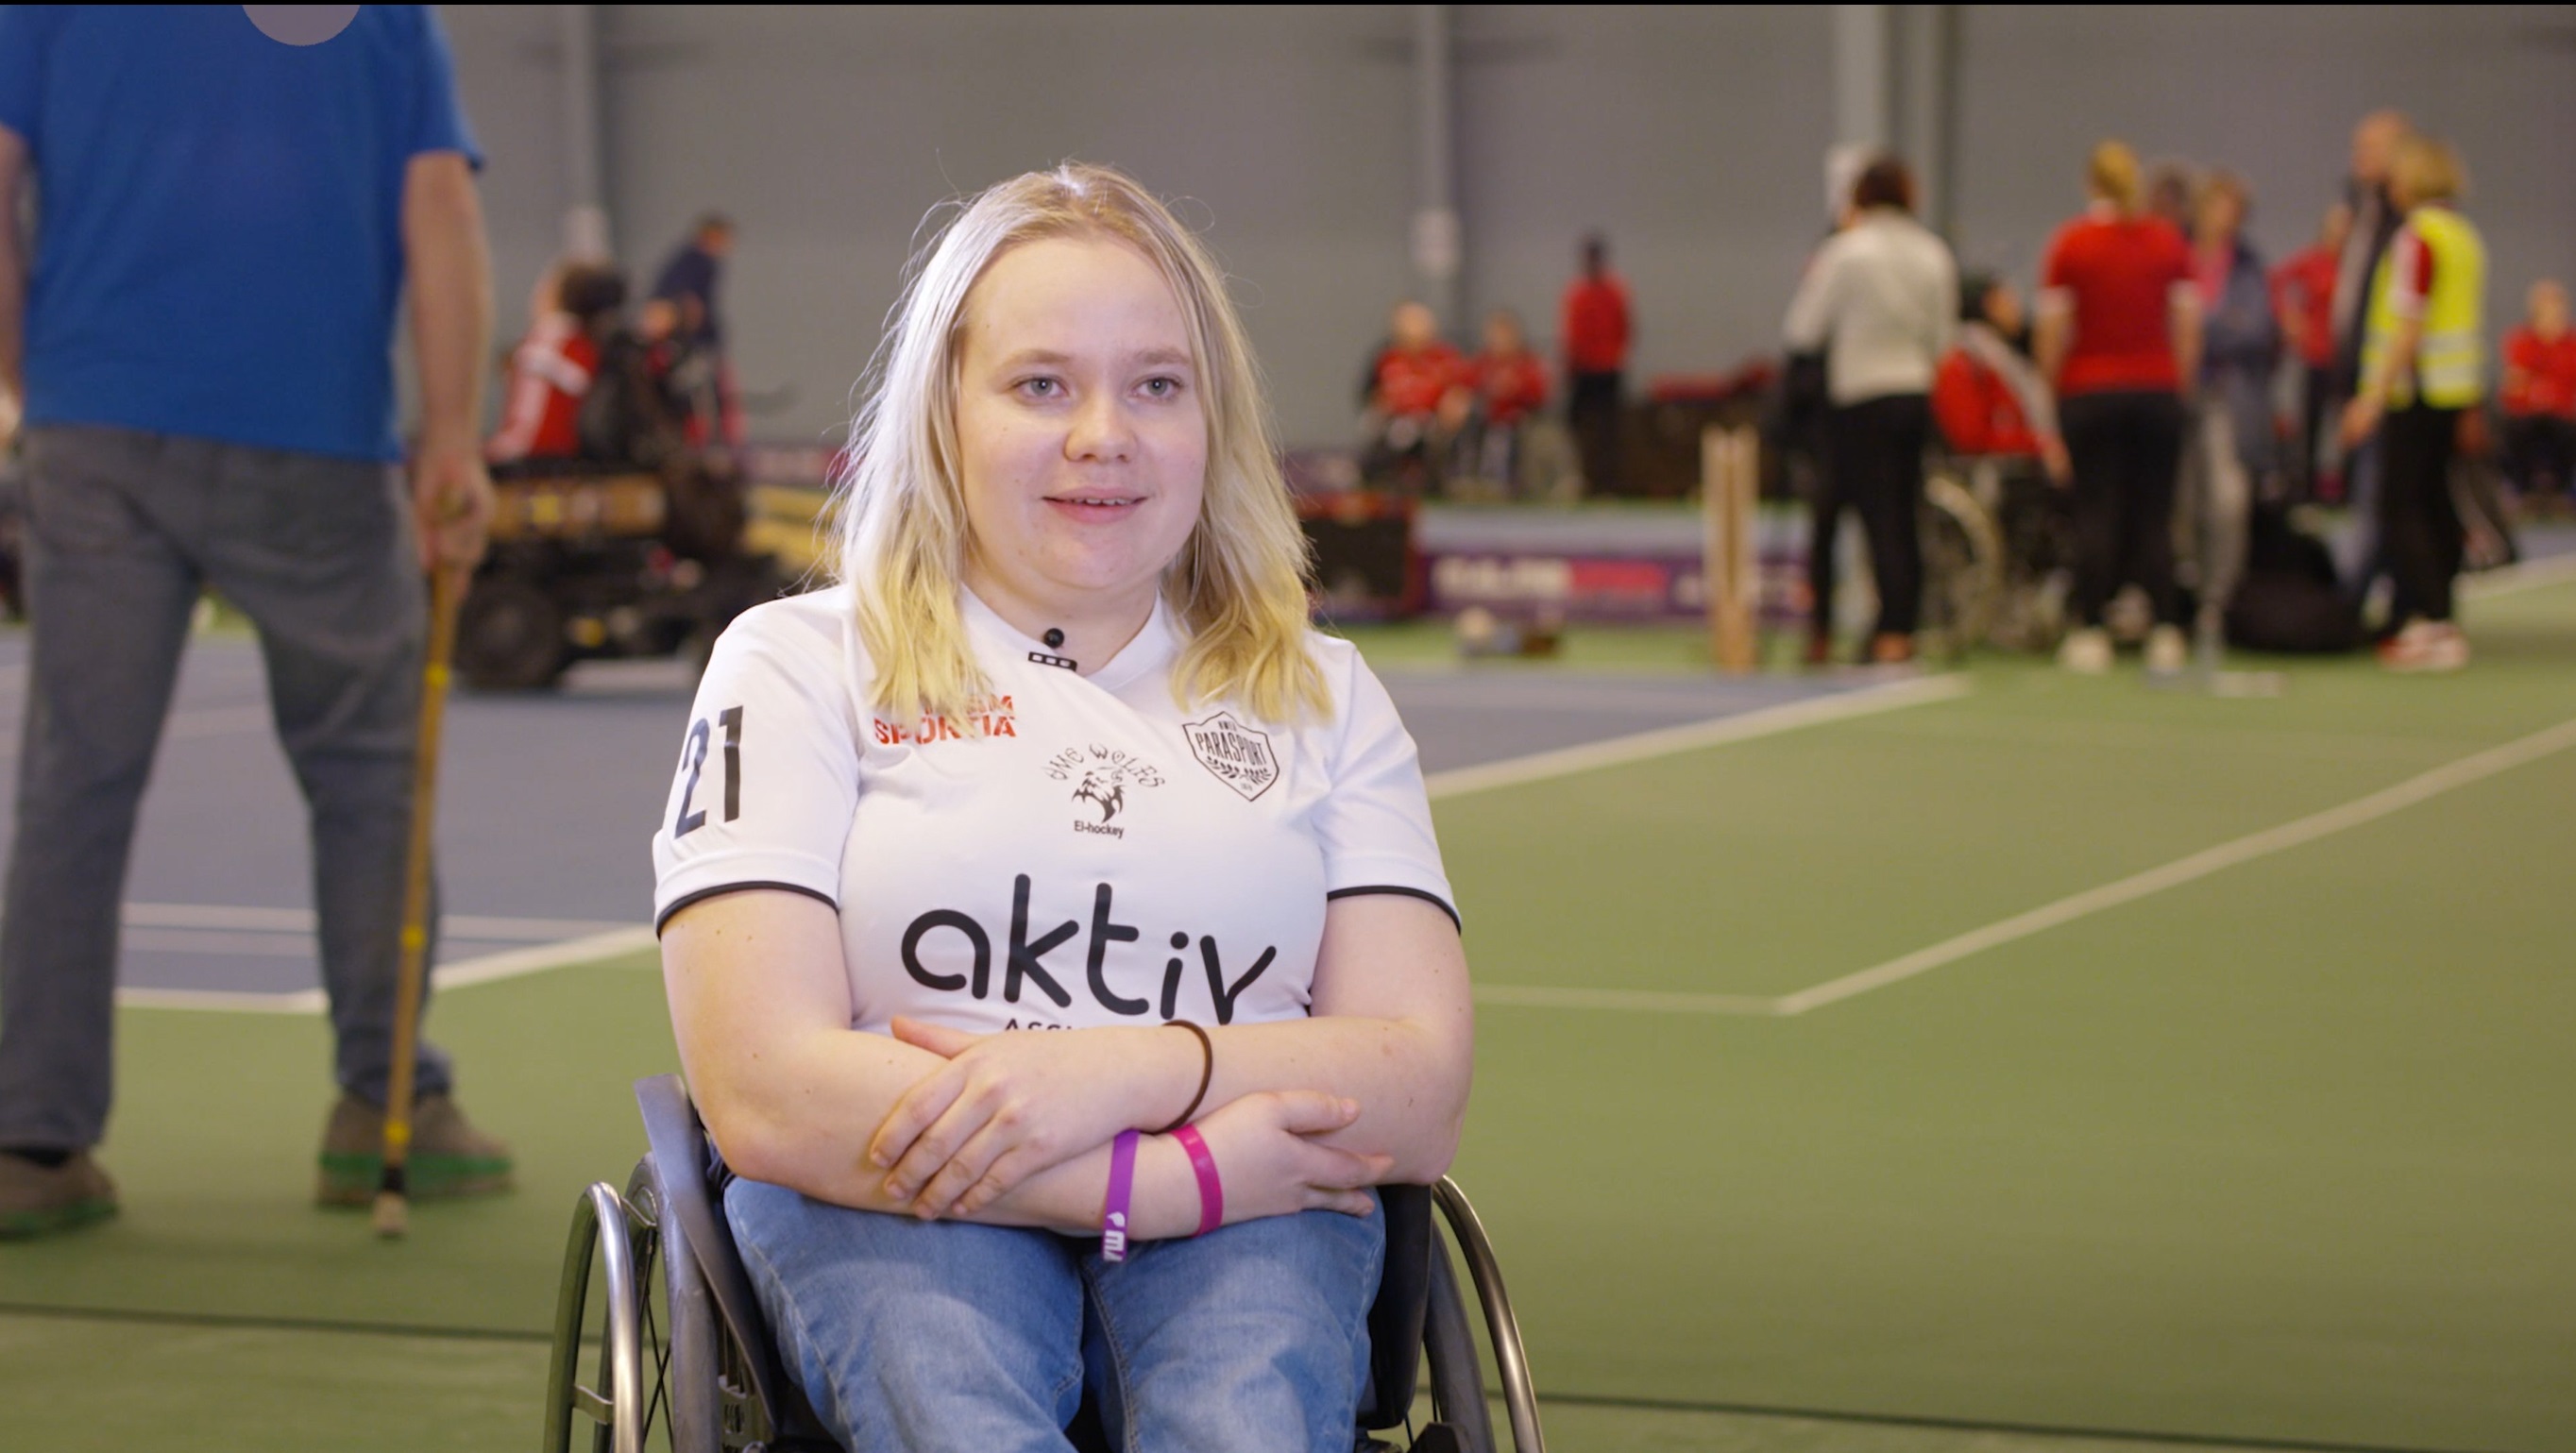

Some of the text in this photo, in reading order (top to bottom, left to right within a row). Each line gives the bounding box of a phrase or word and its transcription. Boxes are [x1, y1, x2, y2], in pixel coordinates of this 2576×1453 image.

[674, 705, 744, 839] 21
[1194, 731, 1267, 767] PARASPORT
[900, 872, 1278, 1025] aktiv
